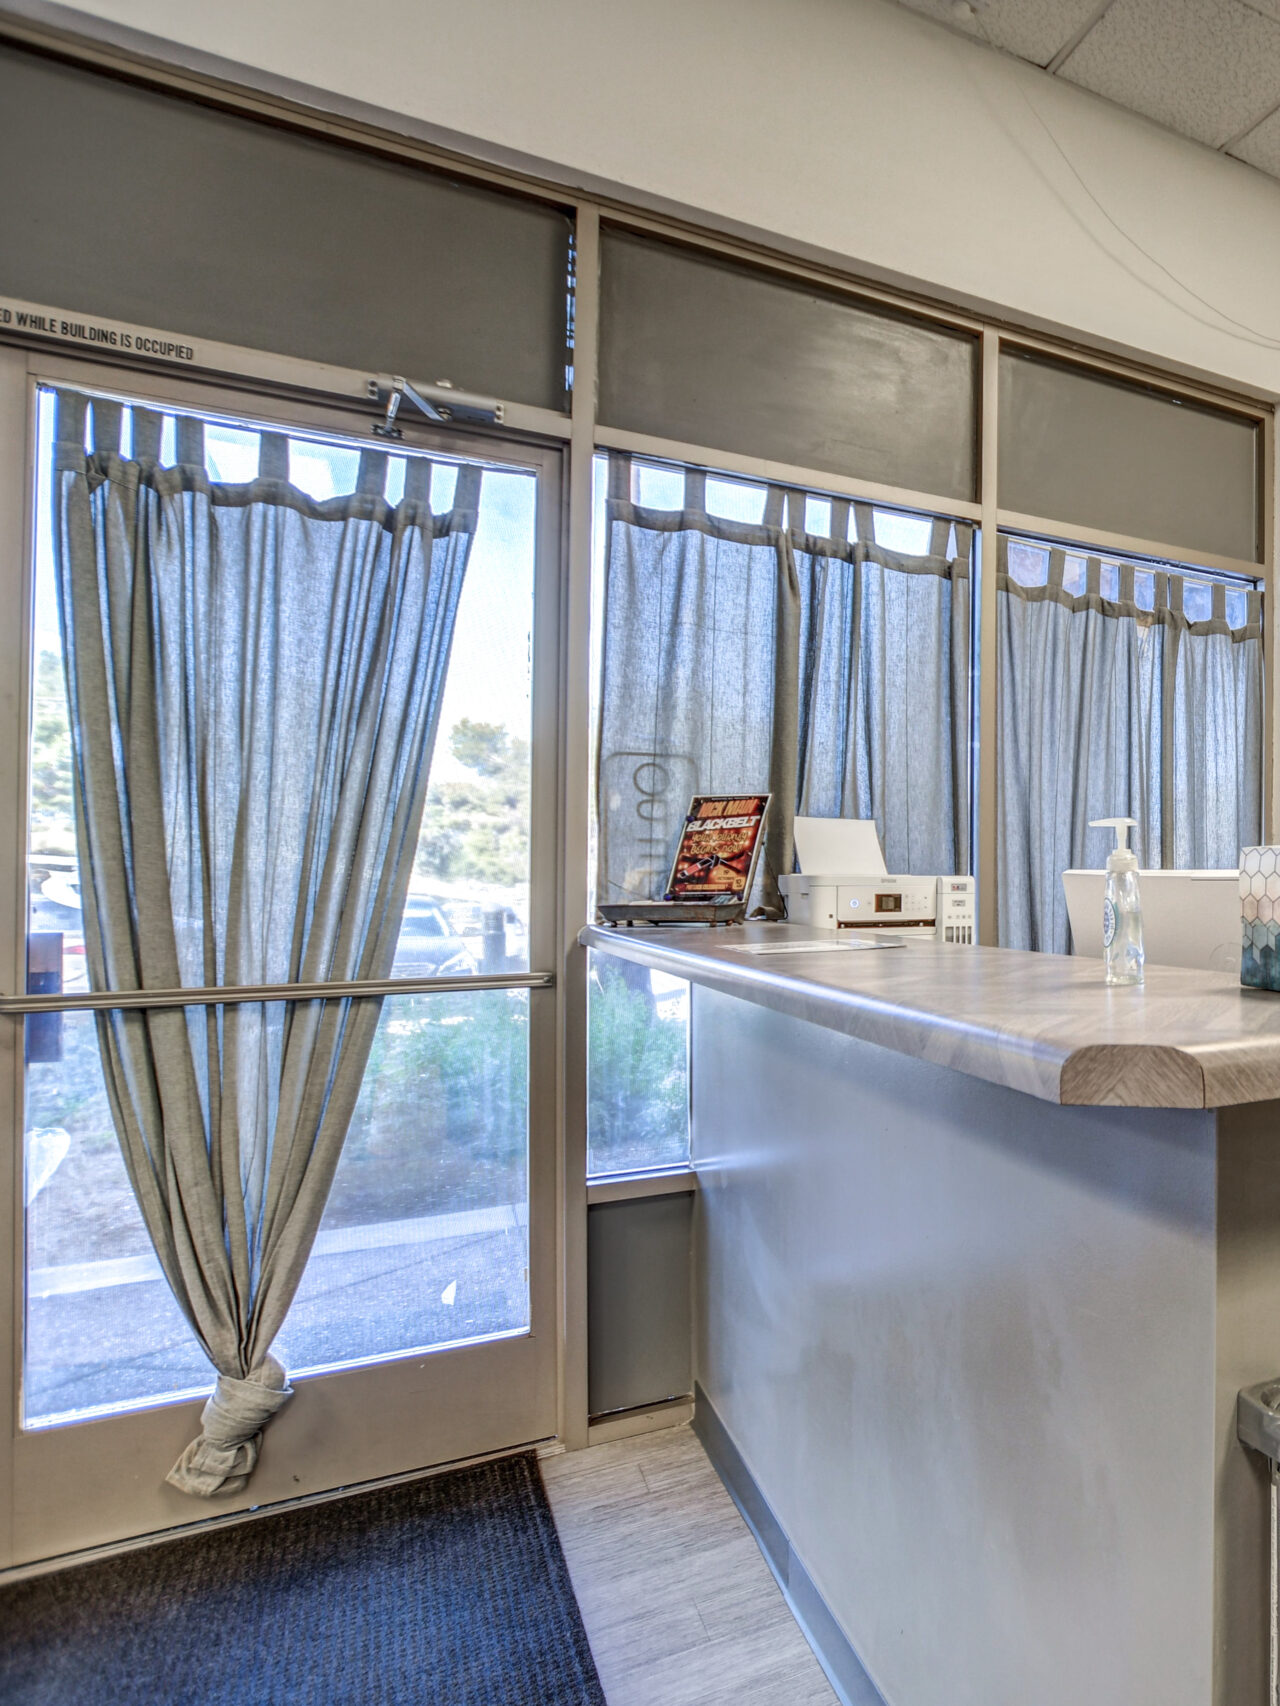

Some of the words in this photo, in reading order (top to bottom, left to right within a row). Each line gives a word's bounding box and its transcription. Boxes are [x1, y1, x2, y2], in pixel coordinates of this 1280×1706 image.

[16, 311, 57, 333] WHILE
[60, 321, 117, 345] BUILDING
[120, 333, 131, 348] IS
[135, 336, 193, 361] OCCUPIED
[686, 815, 761, 832] BLACKBELT
